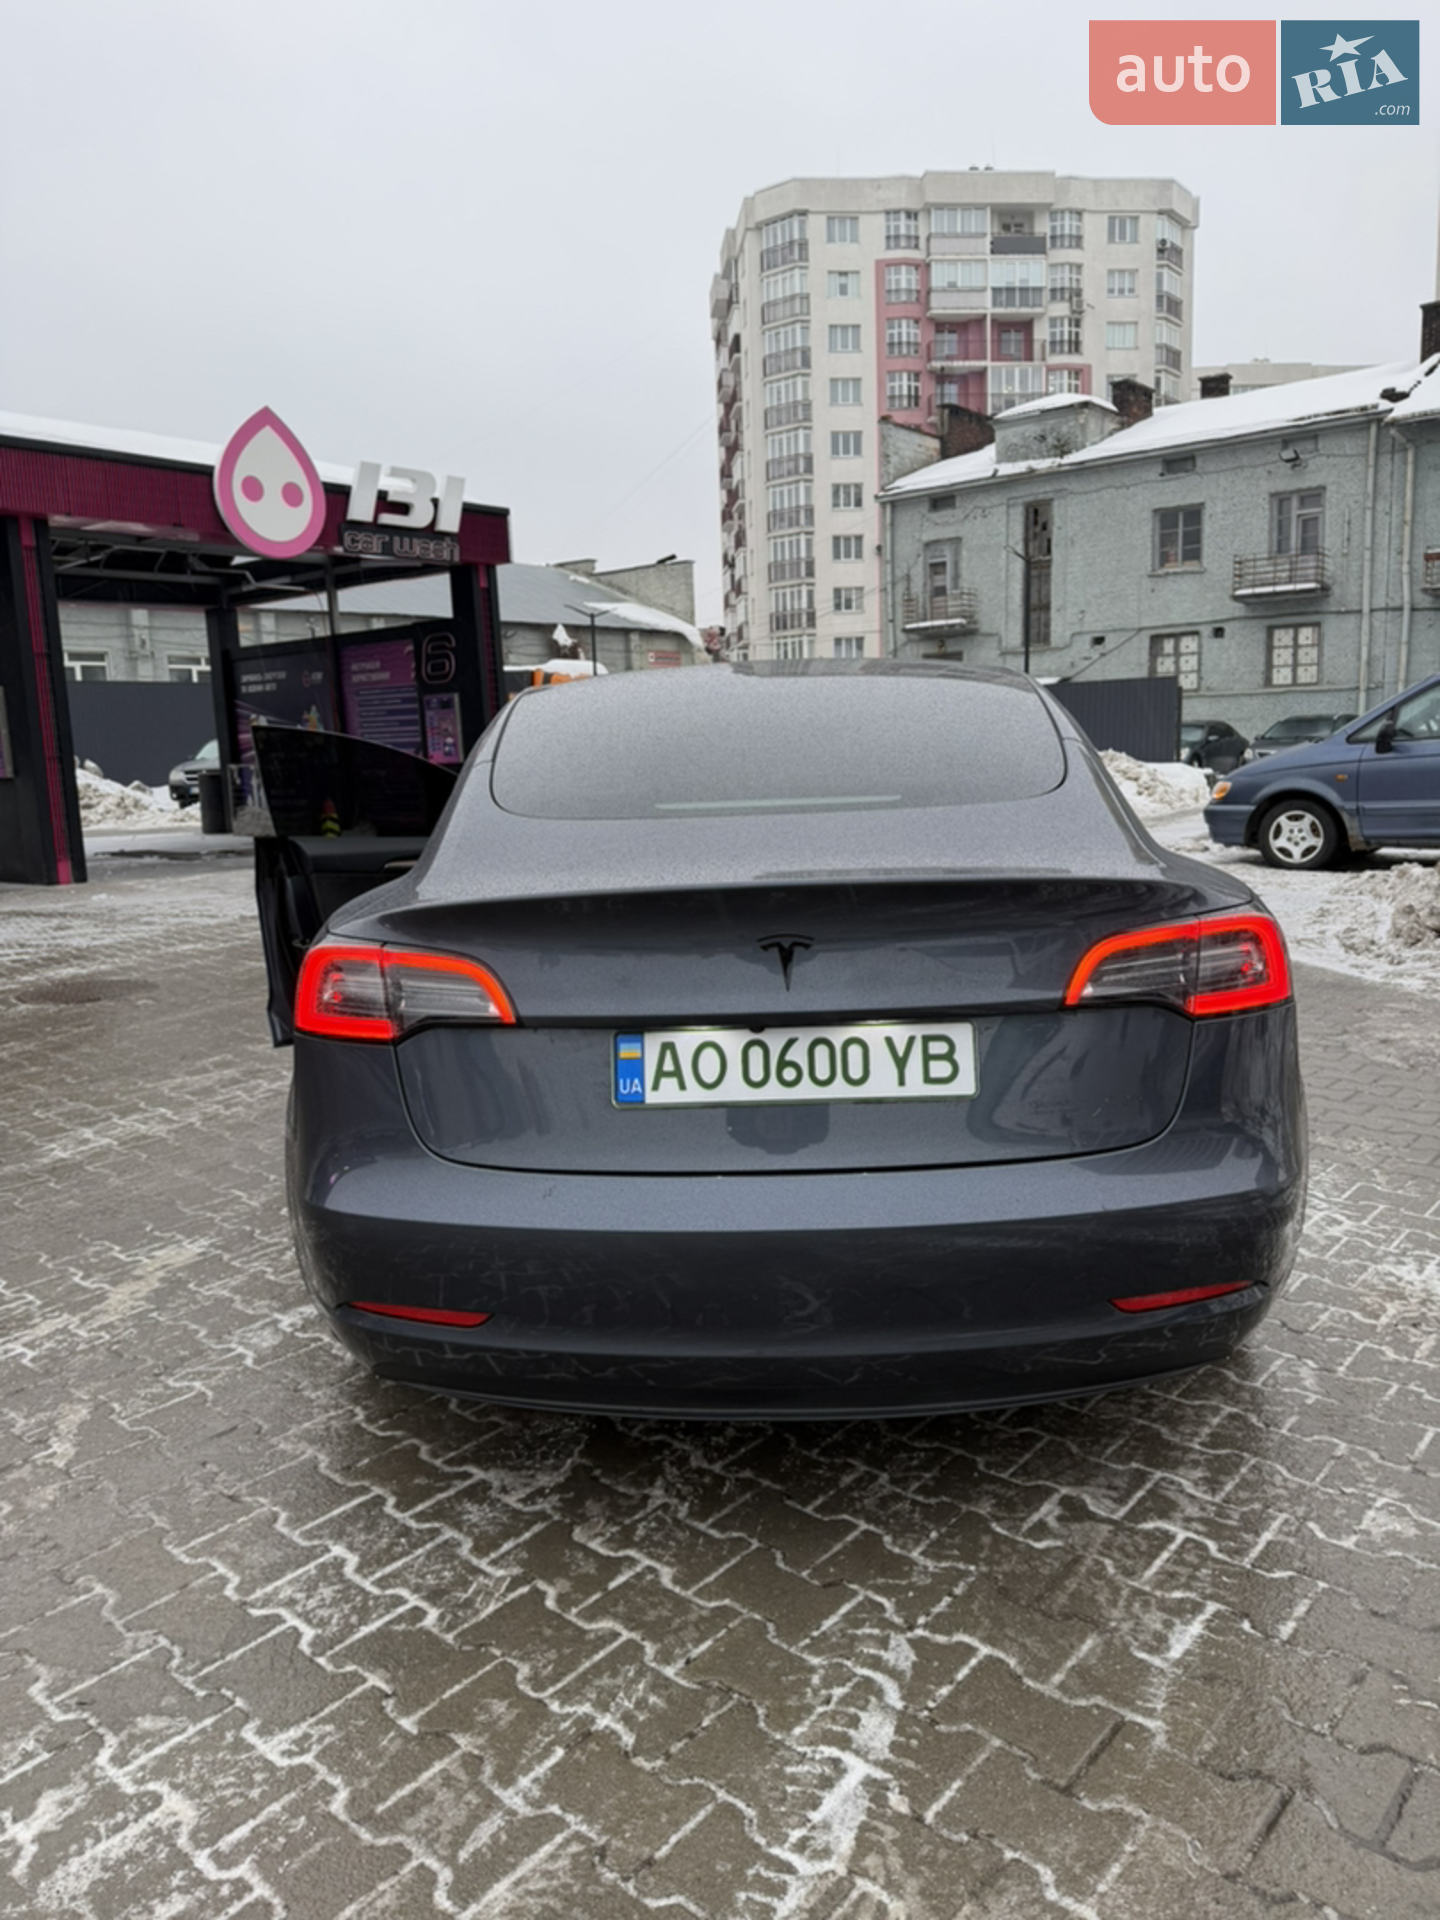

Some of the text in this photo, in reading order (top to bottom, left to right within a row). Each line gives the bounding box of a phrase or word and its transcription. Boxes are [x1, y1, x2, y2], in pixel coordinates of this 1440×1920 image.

[344, 530, 460, 562] car wash
[421, 632, 457, 684] 6
[651, 1034, 960, 1091] AO 0600 YB
[620, 1078, 643, 1094] UA
